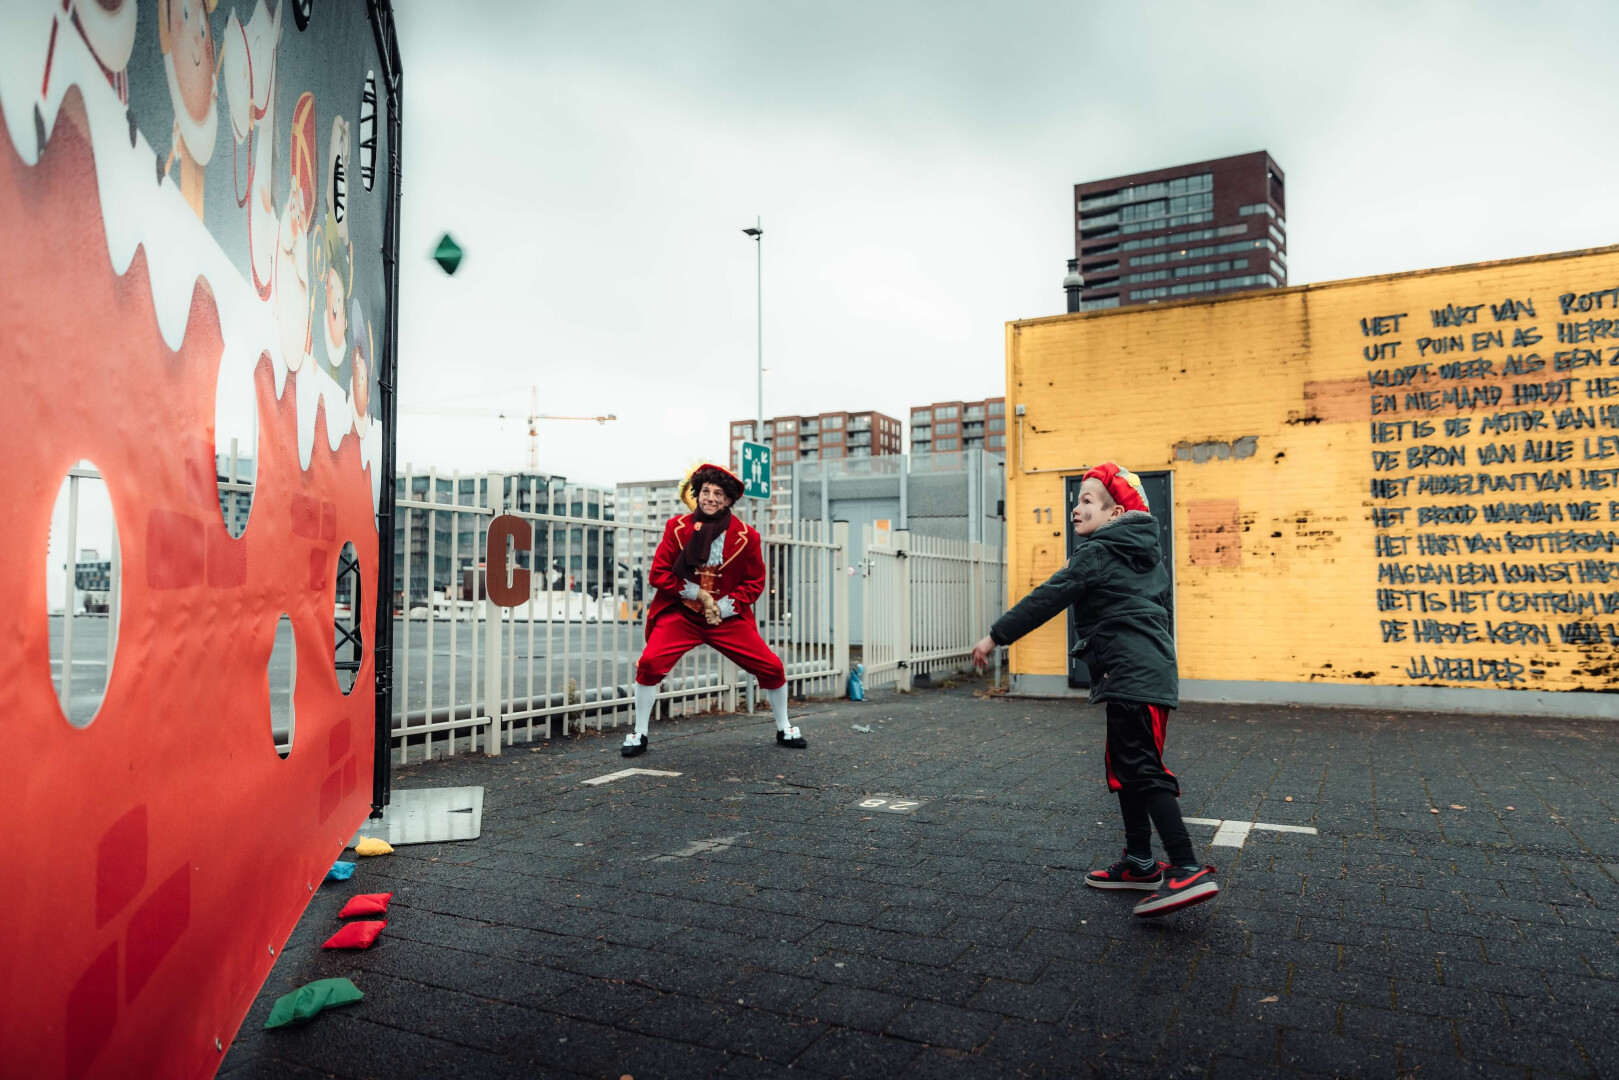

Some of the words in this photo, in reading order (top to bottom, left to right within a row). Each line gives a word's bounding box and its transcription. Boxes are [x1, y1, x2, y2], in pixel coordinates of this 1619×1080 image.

[1360, 312, 1408, 337] HET
[1430, 303, 1486, 328] HART
[1490, 298, 1536, 322] VAN
[1363, 341, 1402, 362] UIT
[1416, 335, 1464, 357] PUIN
[1472, 329, 1504, 352] EN
[1511, 326, 1543, 347] AS
[1502, 353, 1546, 376] ALS
[1554, 348, 1602, 372] EEN
[1371, 394, 1397, 416] EN
[1405, 386, 1502, 411] NIEMAND
[1513, 378, 1580, 406] HOUDT
[1371, 420, 1412, 443] HET
[1412, 420, 1436, 439] IS
[1444, 418, 1471, 438] DE
[1480, 410, 1549, 435] MOTOR
[1552, 405, 1596, 430] VAN
[1372, 451, 1401, 472] DE
[1406, 445, 1466, 469] BRON
[1477, 443, 1516, 466] VAN
[1522, 440, 1573, 463] ALLE
[1371, 476, 1415, 499] HET
[1532, 469, 1573, 492] VAN
[1580, 468, 1619, 491] HET
[1033, 507, 1052, 524] 11
[1372, 507, 1411, 528] HET
[1417, 504, 1478, 527] BROOD
[1482, 501, 1564, 524] WAARVAN
[1565, 501, 1601, 521] WE
[1375, 534, 1412, 557] HET
[1417, 533, 1460, 556] HART
[1463, 533, 1501, 553] VAN
[486, 514, 532, 608] C
[1378, 562, 1415, 584] MAG
[1416, 562, 1453, 585] DAN
[1456, 562, 1497, 585] EEN
[1377, 588, 1418, 612] HET
[1418, 590, 1447, 613] IS
[1450, 589, 1494, 613] HET
[1497, 590, 1598, 616] CENTRUM
[1380, 619, 1408, 643] DE
[1413, 619, 1478, 644] HARDE
[1485, 620, 1551, 645] KERN
[1558, 622, 1603, 645] VAN
